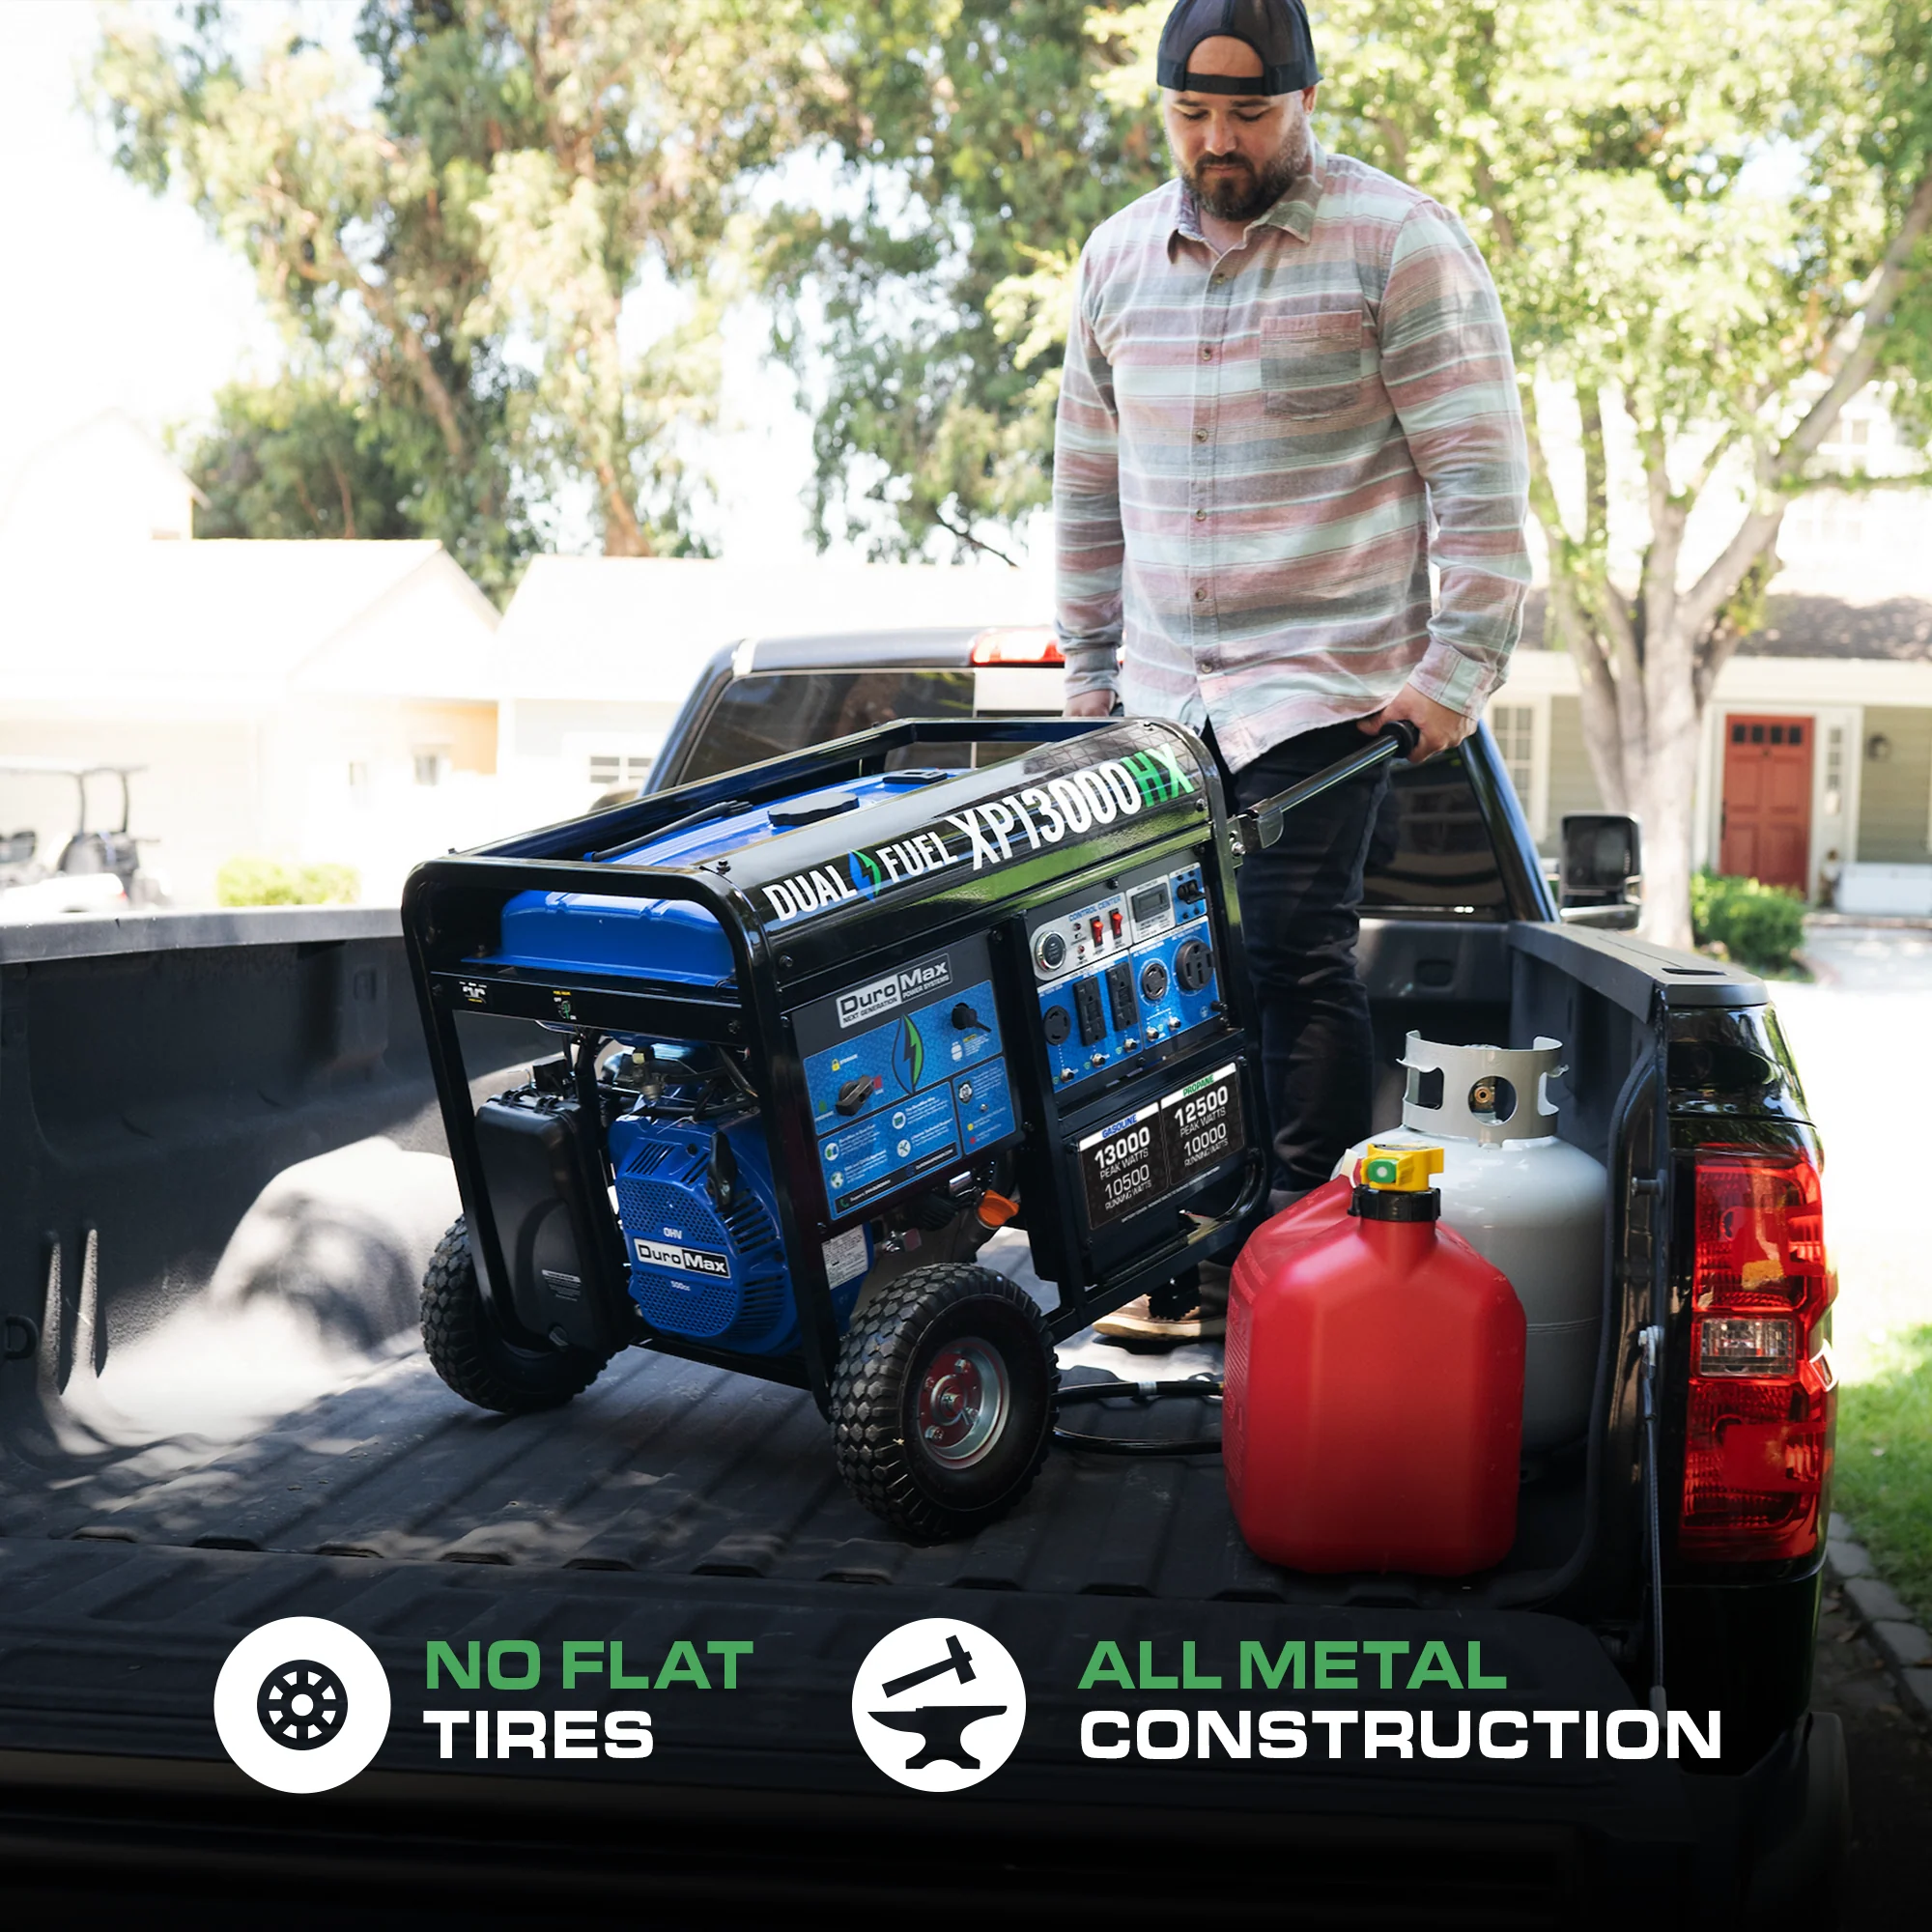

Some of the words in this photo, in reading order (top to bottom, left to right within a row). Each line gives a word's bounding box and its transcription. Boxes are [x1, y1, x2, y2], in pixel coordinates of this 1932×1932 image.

[762, 866, 857, 921] DUAL
[876, 833, 957, 883] FUEL
[944, 744, 1194, 869] XP13000HX
[1182, 1074, 1213, 1096] PROPANE
[1175, 1086, 1228, 1126] 12500
[1101, 1115, 1137, 1138] GASOLINE
[1179, 1122, 1199, 1138] PEAK
[1201, 1107, 1225, 1128] WATTS
[1094, 1126, 1150, 1169] 13000
[1183, 1148, 1208, 1166] RUNNING
[1208, 1140, 1228, 1155] WATTS
[1184, 1123, 1226, 1156] 10000
[1099, 1163, 1121, 1180] PEAK
[1122, 1149, 1148, 1169] WATTS
[1105, 1165, 1150, 1199] 10500
[1105, 1189, 1131, 1210] RUNNING
[1131, 1180, 1151, 1198] WATTS
[663, 1228, 682, 1239] OHV
